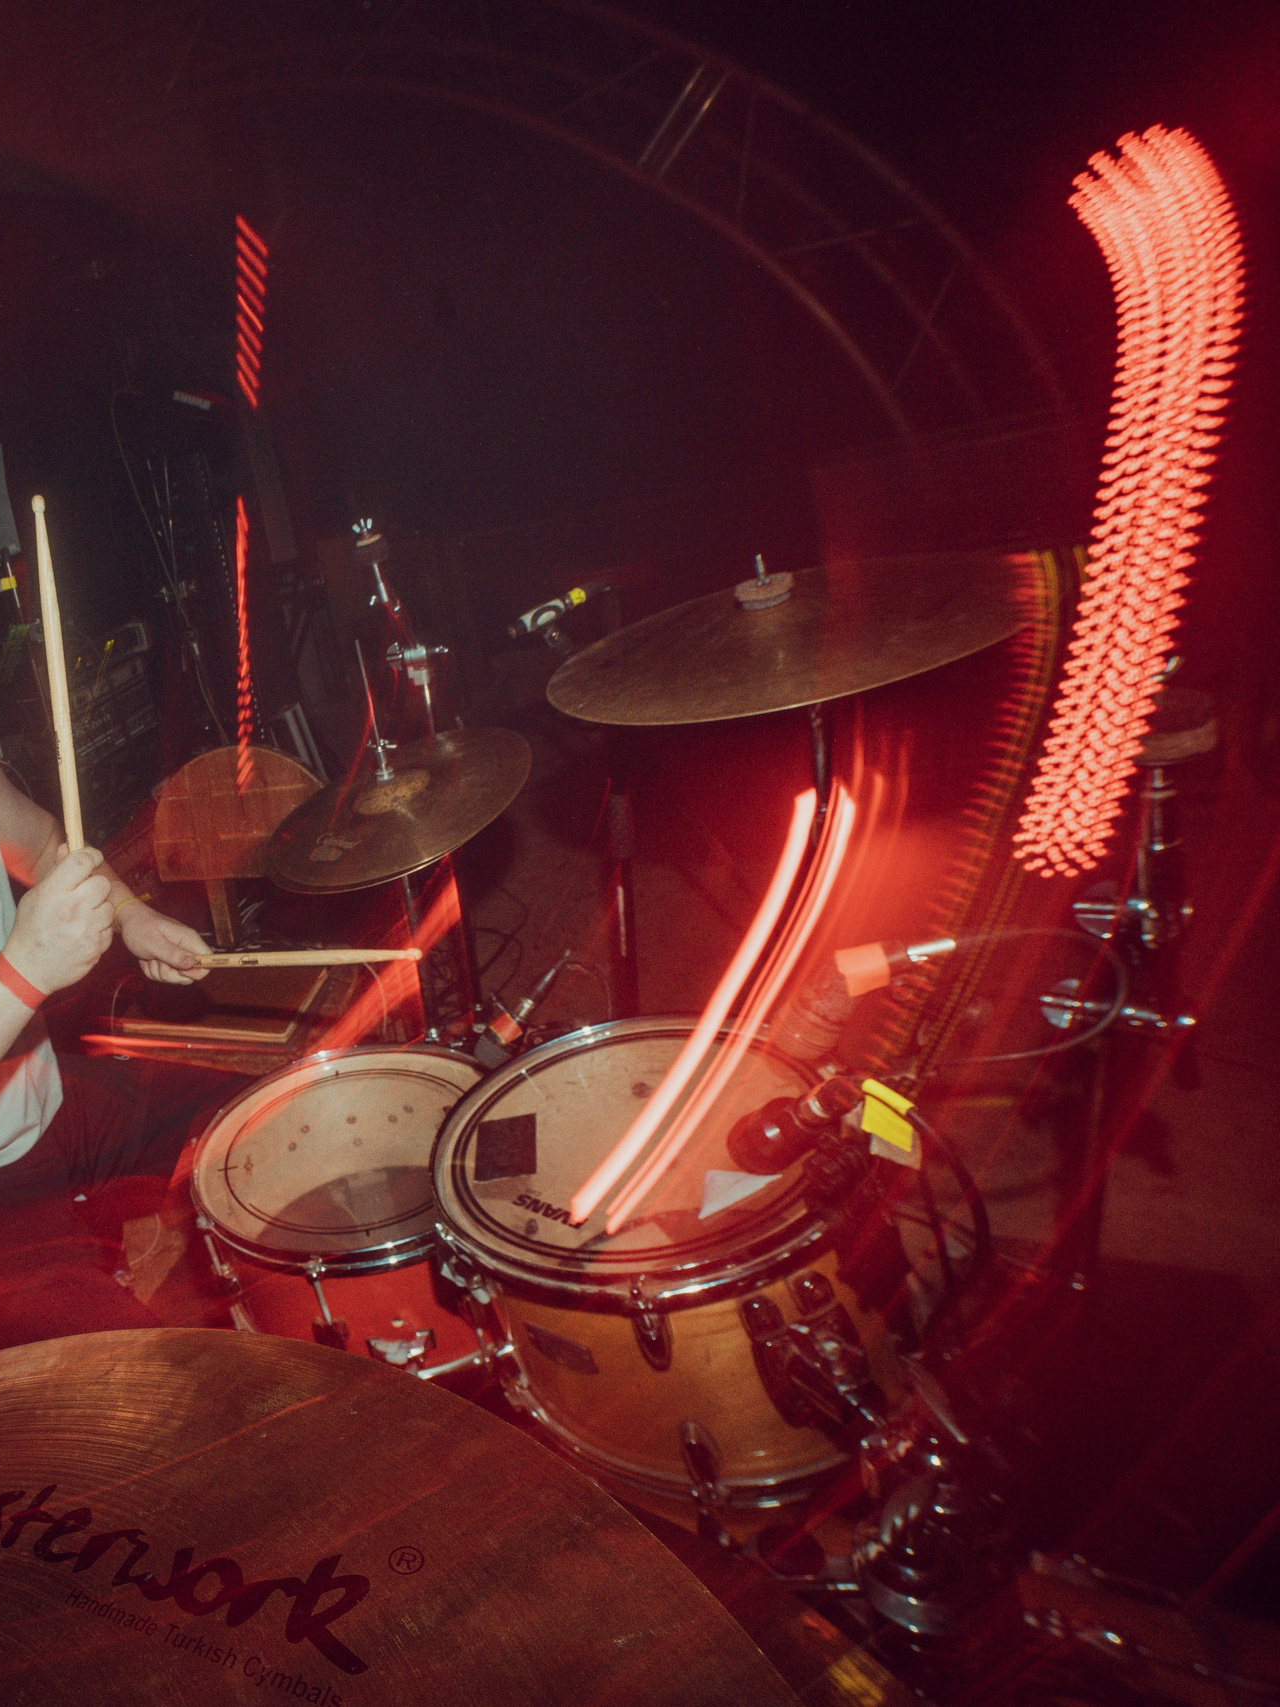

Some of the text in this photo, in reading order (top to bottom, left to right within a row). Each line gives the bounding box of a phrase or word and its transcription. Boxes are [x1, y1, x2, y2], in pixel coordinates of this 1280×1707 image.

[65, 1587, 344, 1707] Handmade Turkish Cymbals
